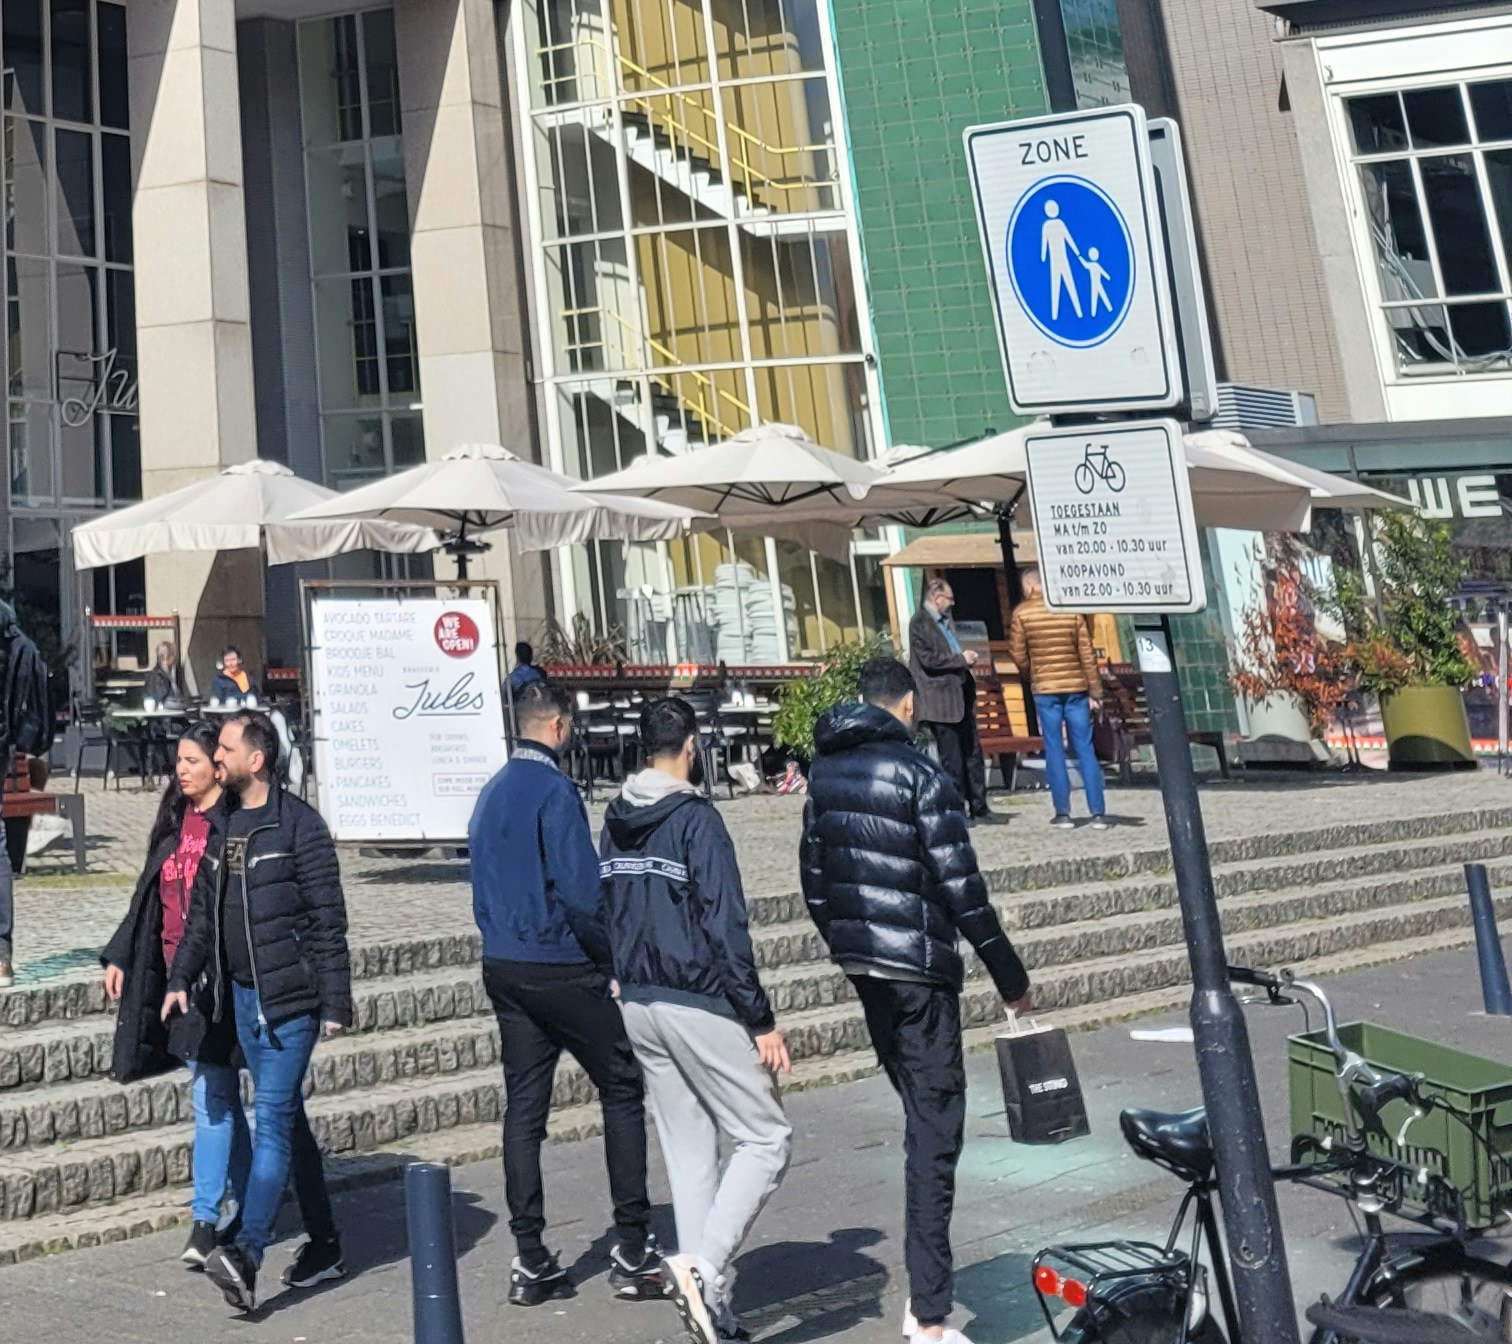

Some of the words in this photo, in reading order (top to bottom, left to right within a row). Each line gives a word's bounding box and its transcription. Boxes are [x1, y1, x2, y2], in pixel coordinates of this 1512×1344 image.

[1019, 135, 1088, 165] ZONE
[1408, 475, 1503, 519] WE
[1050, 502, 1120, 519] TOEGESTAAN
[1054, 523, 1069, 536] MA
[1072, 522, 1089, 536] t/m
[1093, 521, 1107, 535] ZO
[1056, 543, 1074, 555] van
[1077, 540, 1106, 554] 20.00
[1117, 539, 1145, 553] 10.30
[1148, 540, 1167, 552] uur
[1060, 563, 1125, 578] KOOPAVOND
[1062, 585, 1080, 597] van
[1083, 583, 1112, 596] 22.00
[1123, 582, 1151, 595] 10.30
[1154, 583, 1173, 595] uur
[324, 612, 370, 624] AVOCADO
[374, 612, 417, 625] TARTARE
[442, 616, 461, 629] WE
[324, 630, 366, 642] CROQUE
[369, 630, 414, 641] MADAME
[438, 628, 459, 640] ARE
[442, 638, 474, 651] OPEN!
[1138, 637, 1154, 653] 13
[326, 647, 373, 660] BROODJE
[327, 666, 350, 678] KIDS
[353, 666, 384, 678] MENU
[328, 683, 378, 696] GRANOLA
[392, 671, 485, 720] Jules
[330, 701, 369, 714] SALADS
[330, 720, 365, 732] CAKES
[332, 738, 380, 751] OMELETS
[334, 757, 383, 770] BURGERS
[336, 775, 392, 789] PANCAKES
[337, 793, 408, 808] SANDWICHES
[338, 813, 367, 827] EGGS
[370, 813, 421, 827] BENEDICT
